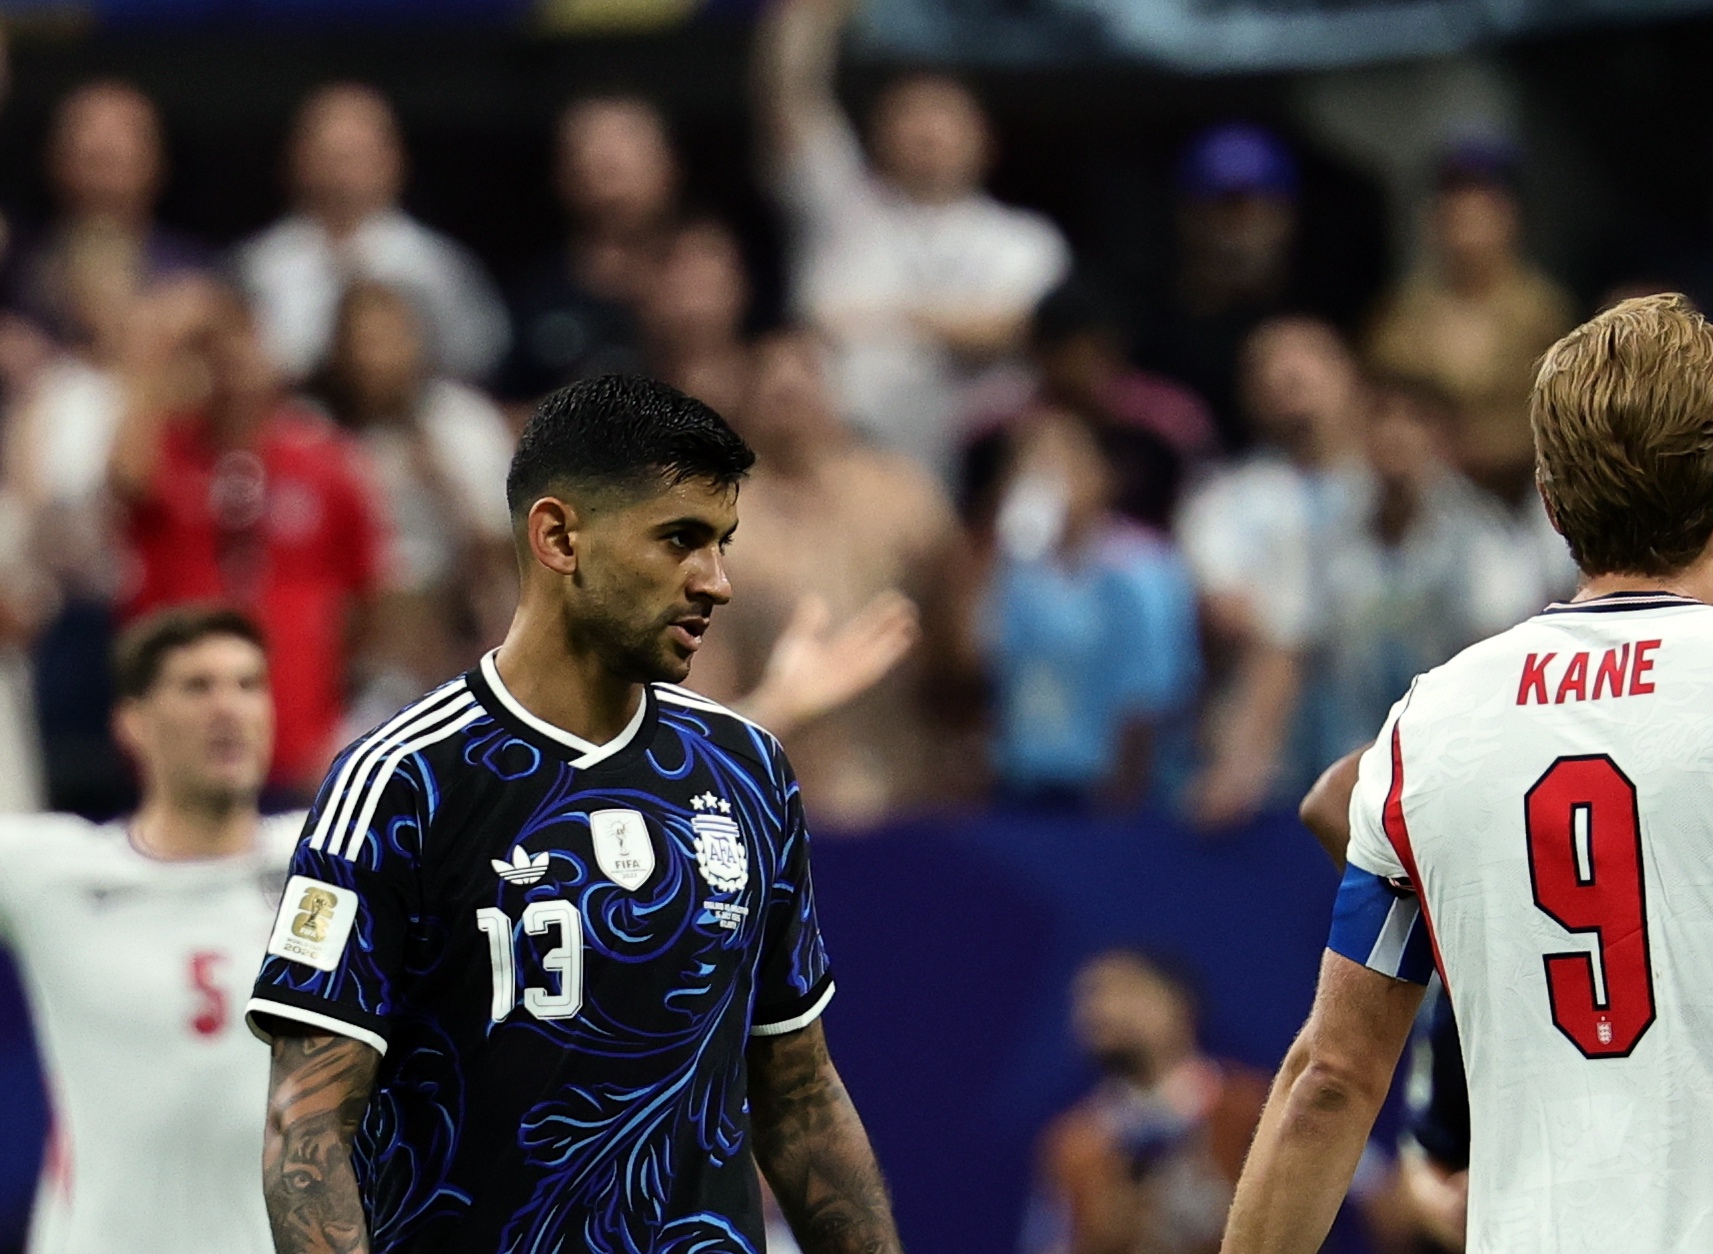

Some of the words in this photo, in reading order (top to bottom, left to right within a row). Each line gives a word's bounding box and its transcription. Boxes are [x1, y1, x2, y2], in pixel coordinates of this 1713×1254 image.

[1516, 639, 1663, 706] KANE
[615, 859, 641, 870] FIFA
[709, 832, 738, 869] AFA
[1524, 753, 1657, 1060] 9
[188, 949, 229, 1036] 5
[476, 899, 584, 1023] 13
